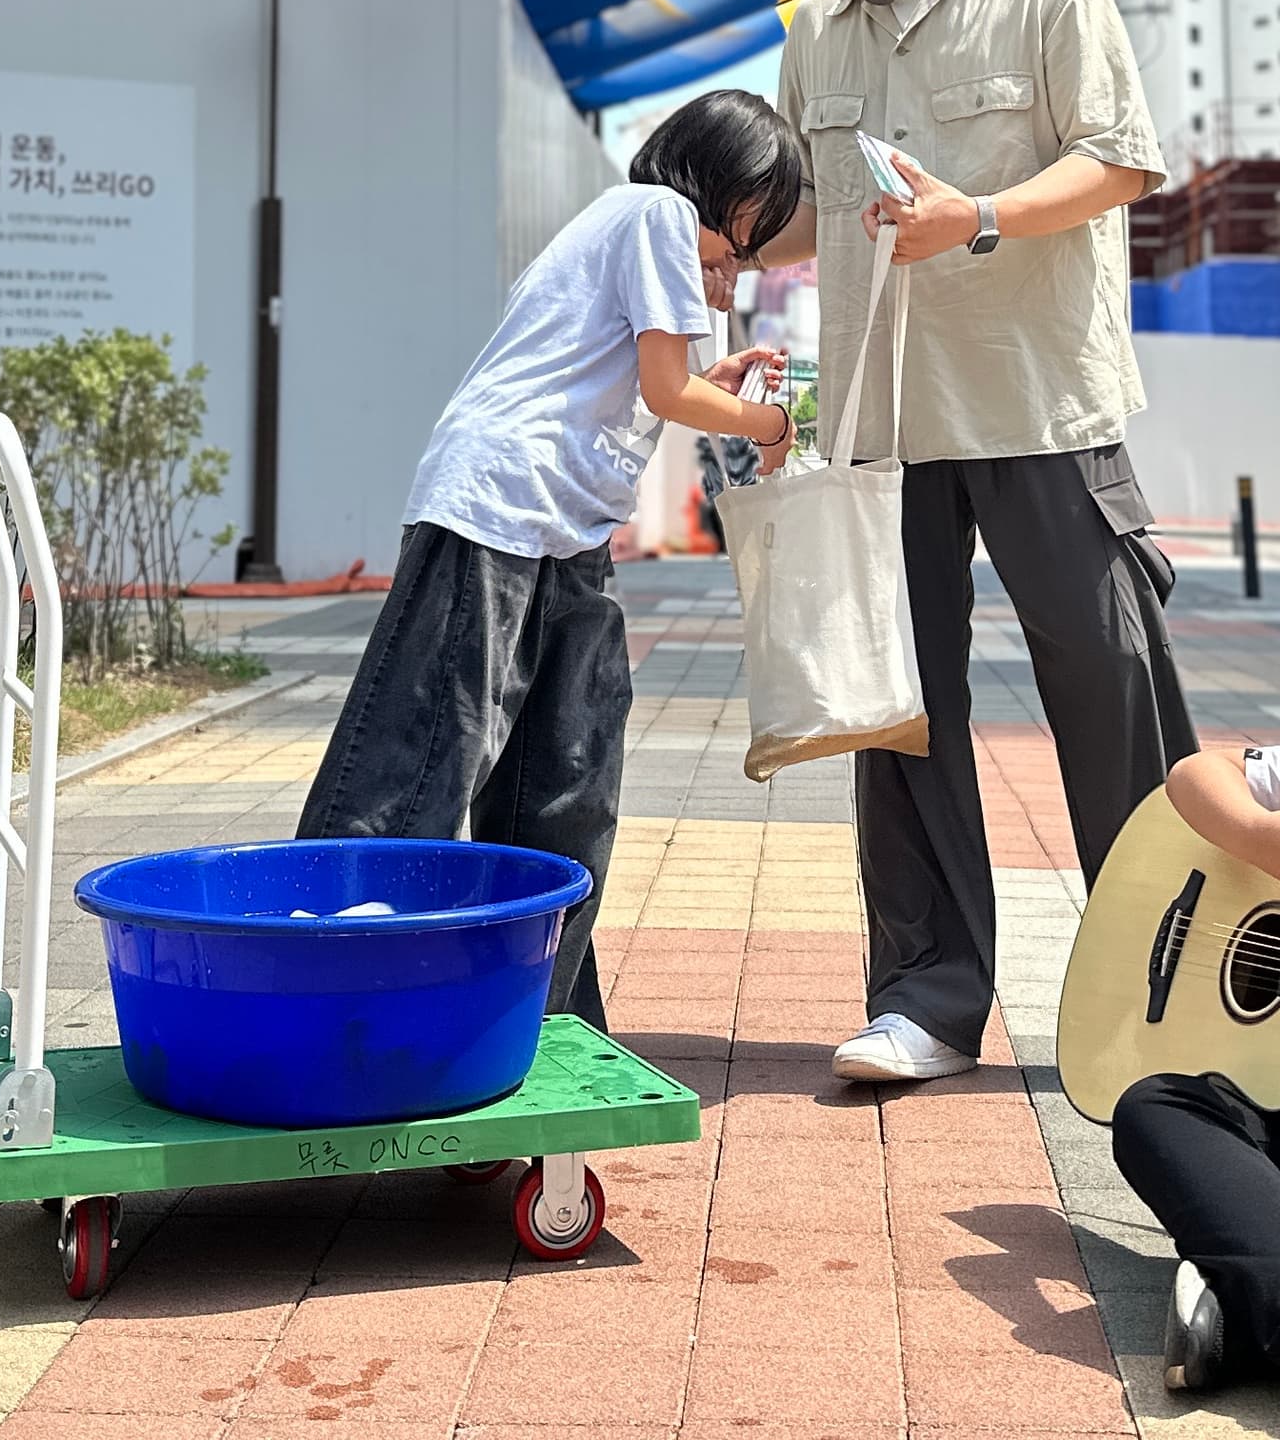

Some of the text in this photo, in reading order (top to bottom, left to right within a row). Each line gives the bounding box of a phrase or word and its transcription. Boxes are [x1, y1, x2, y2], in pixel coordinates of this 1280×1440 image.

[10, 134, 67, 166] 운동,
[10, 168, 66, 198] 가치,
[72, 171, 155, 198] 쓰리GO
